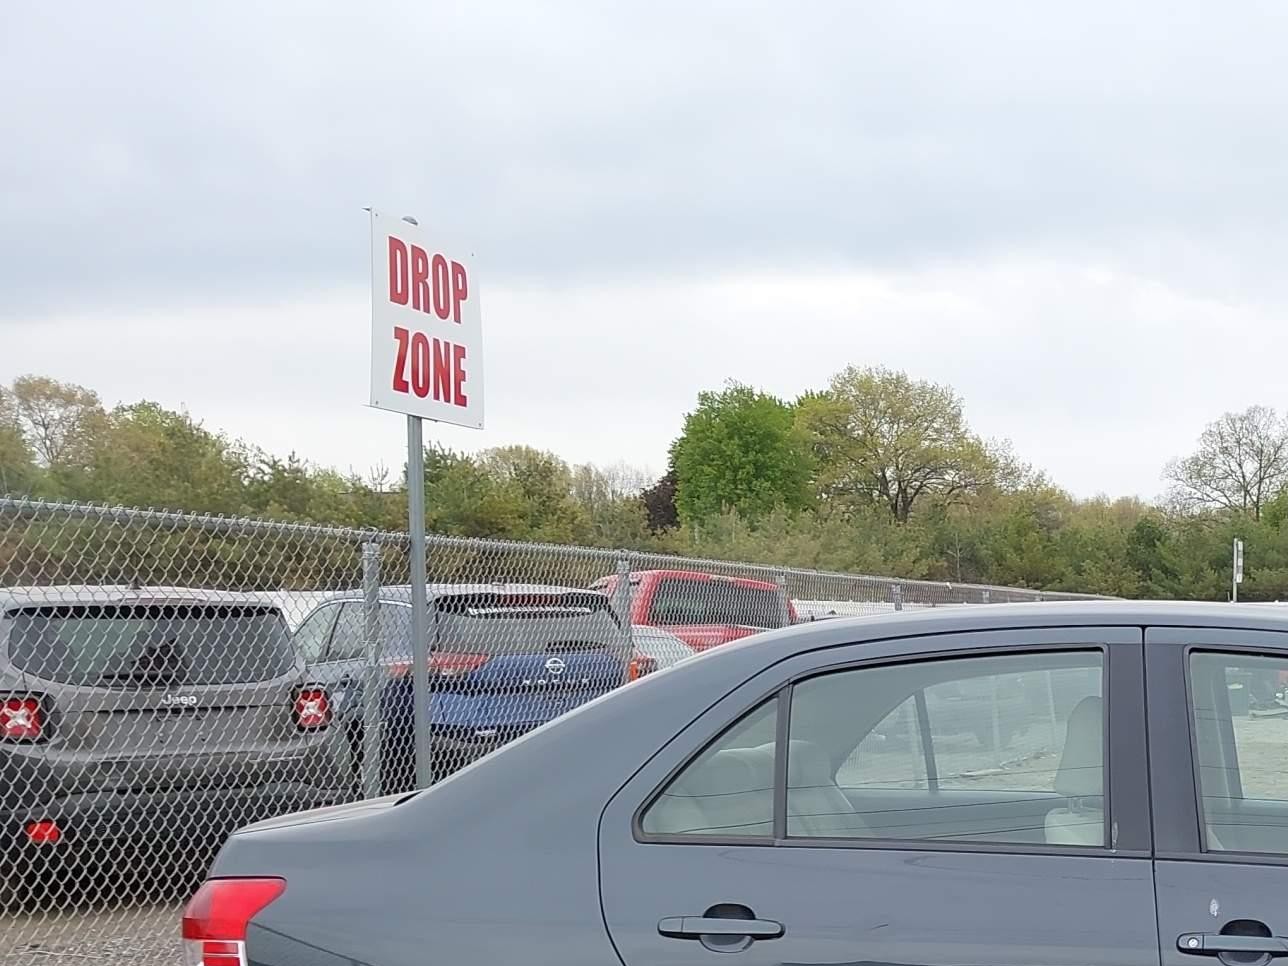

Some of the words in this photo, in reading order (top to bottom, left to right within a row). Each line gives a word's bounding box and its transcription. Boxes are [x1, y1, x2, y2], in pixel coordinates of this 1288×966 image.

[388, 236, 468, 324] DROP
[392, 326, 468, 408] ZONE
[161, 694, 197, 706] Jeep
